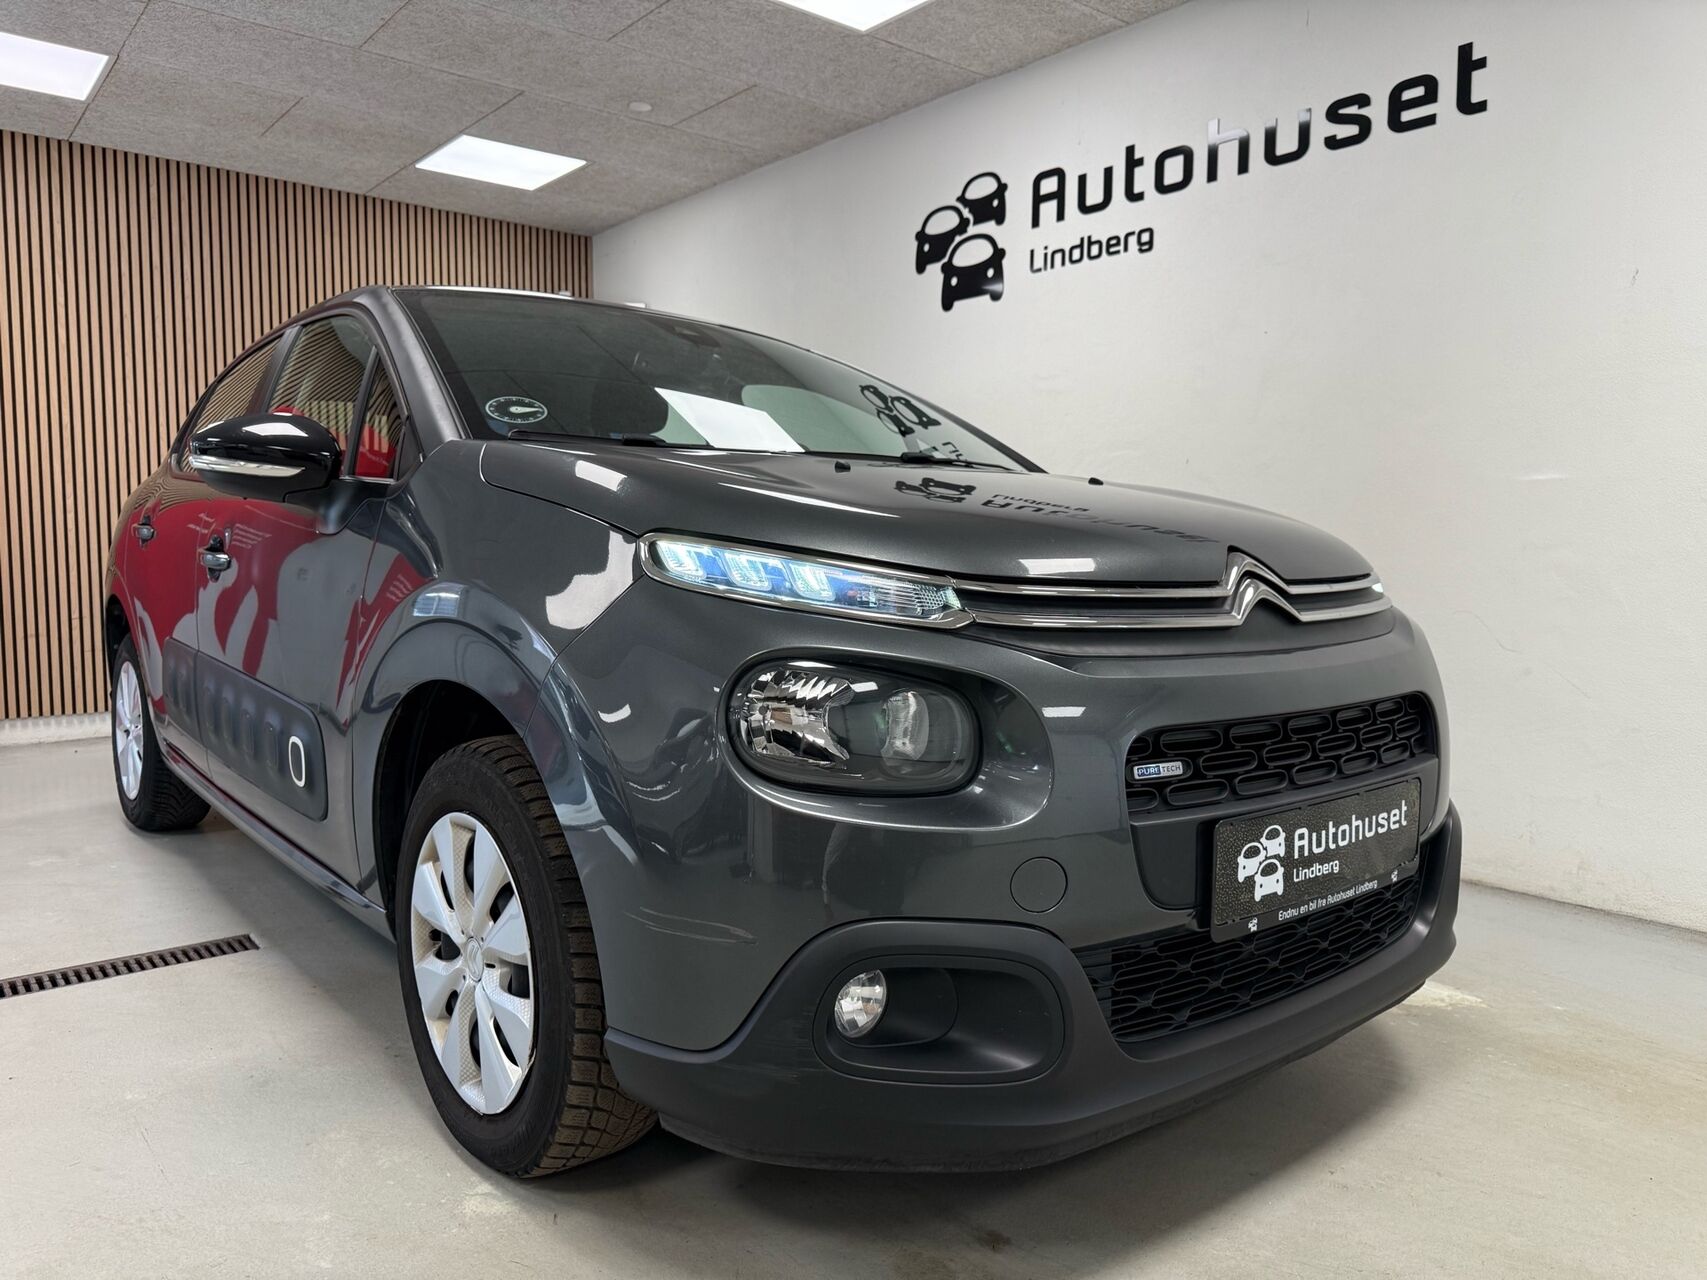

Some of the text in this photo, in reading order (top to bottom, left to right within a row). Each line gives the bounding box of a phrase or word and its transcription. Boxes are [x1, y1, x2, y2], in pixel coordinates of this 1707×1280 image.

[1031, 41, 1488, 229] Autohuset
[1030, 227, 1155, 273] Lindberg
[1161, 765, 1181, 773] TECH
[1294, 800, 1407, 859] Autohuset
[1294, 860, 1339, 882] Lindberg
[1278, 907, 1299, 920] Endnu
[1300, 904, 1308, 914] en
[1309, 900, 1317, 911] bil
[1327, 886, 1356, 905] Autohuset
[1355, 880, 1378, 894] Lindberg
